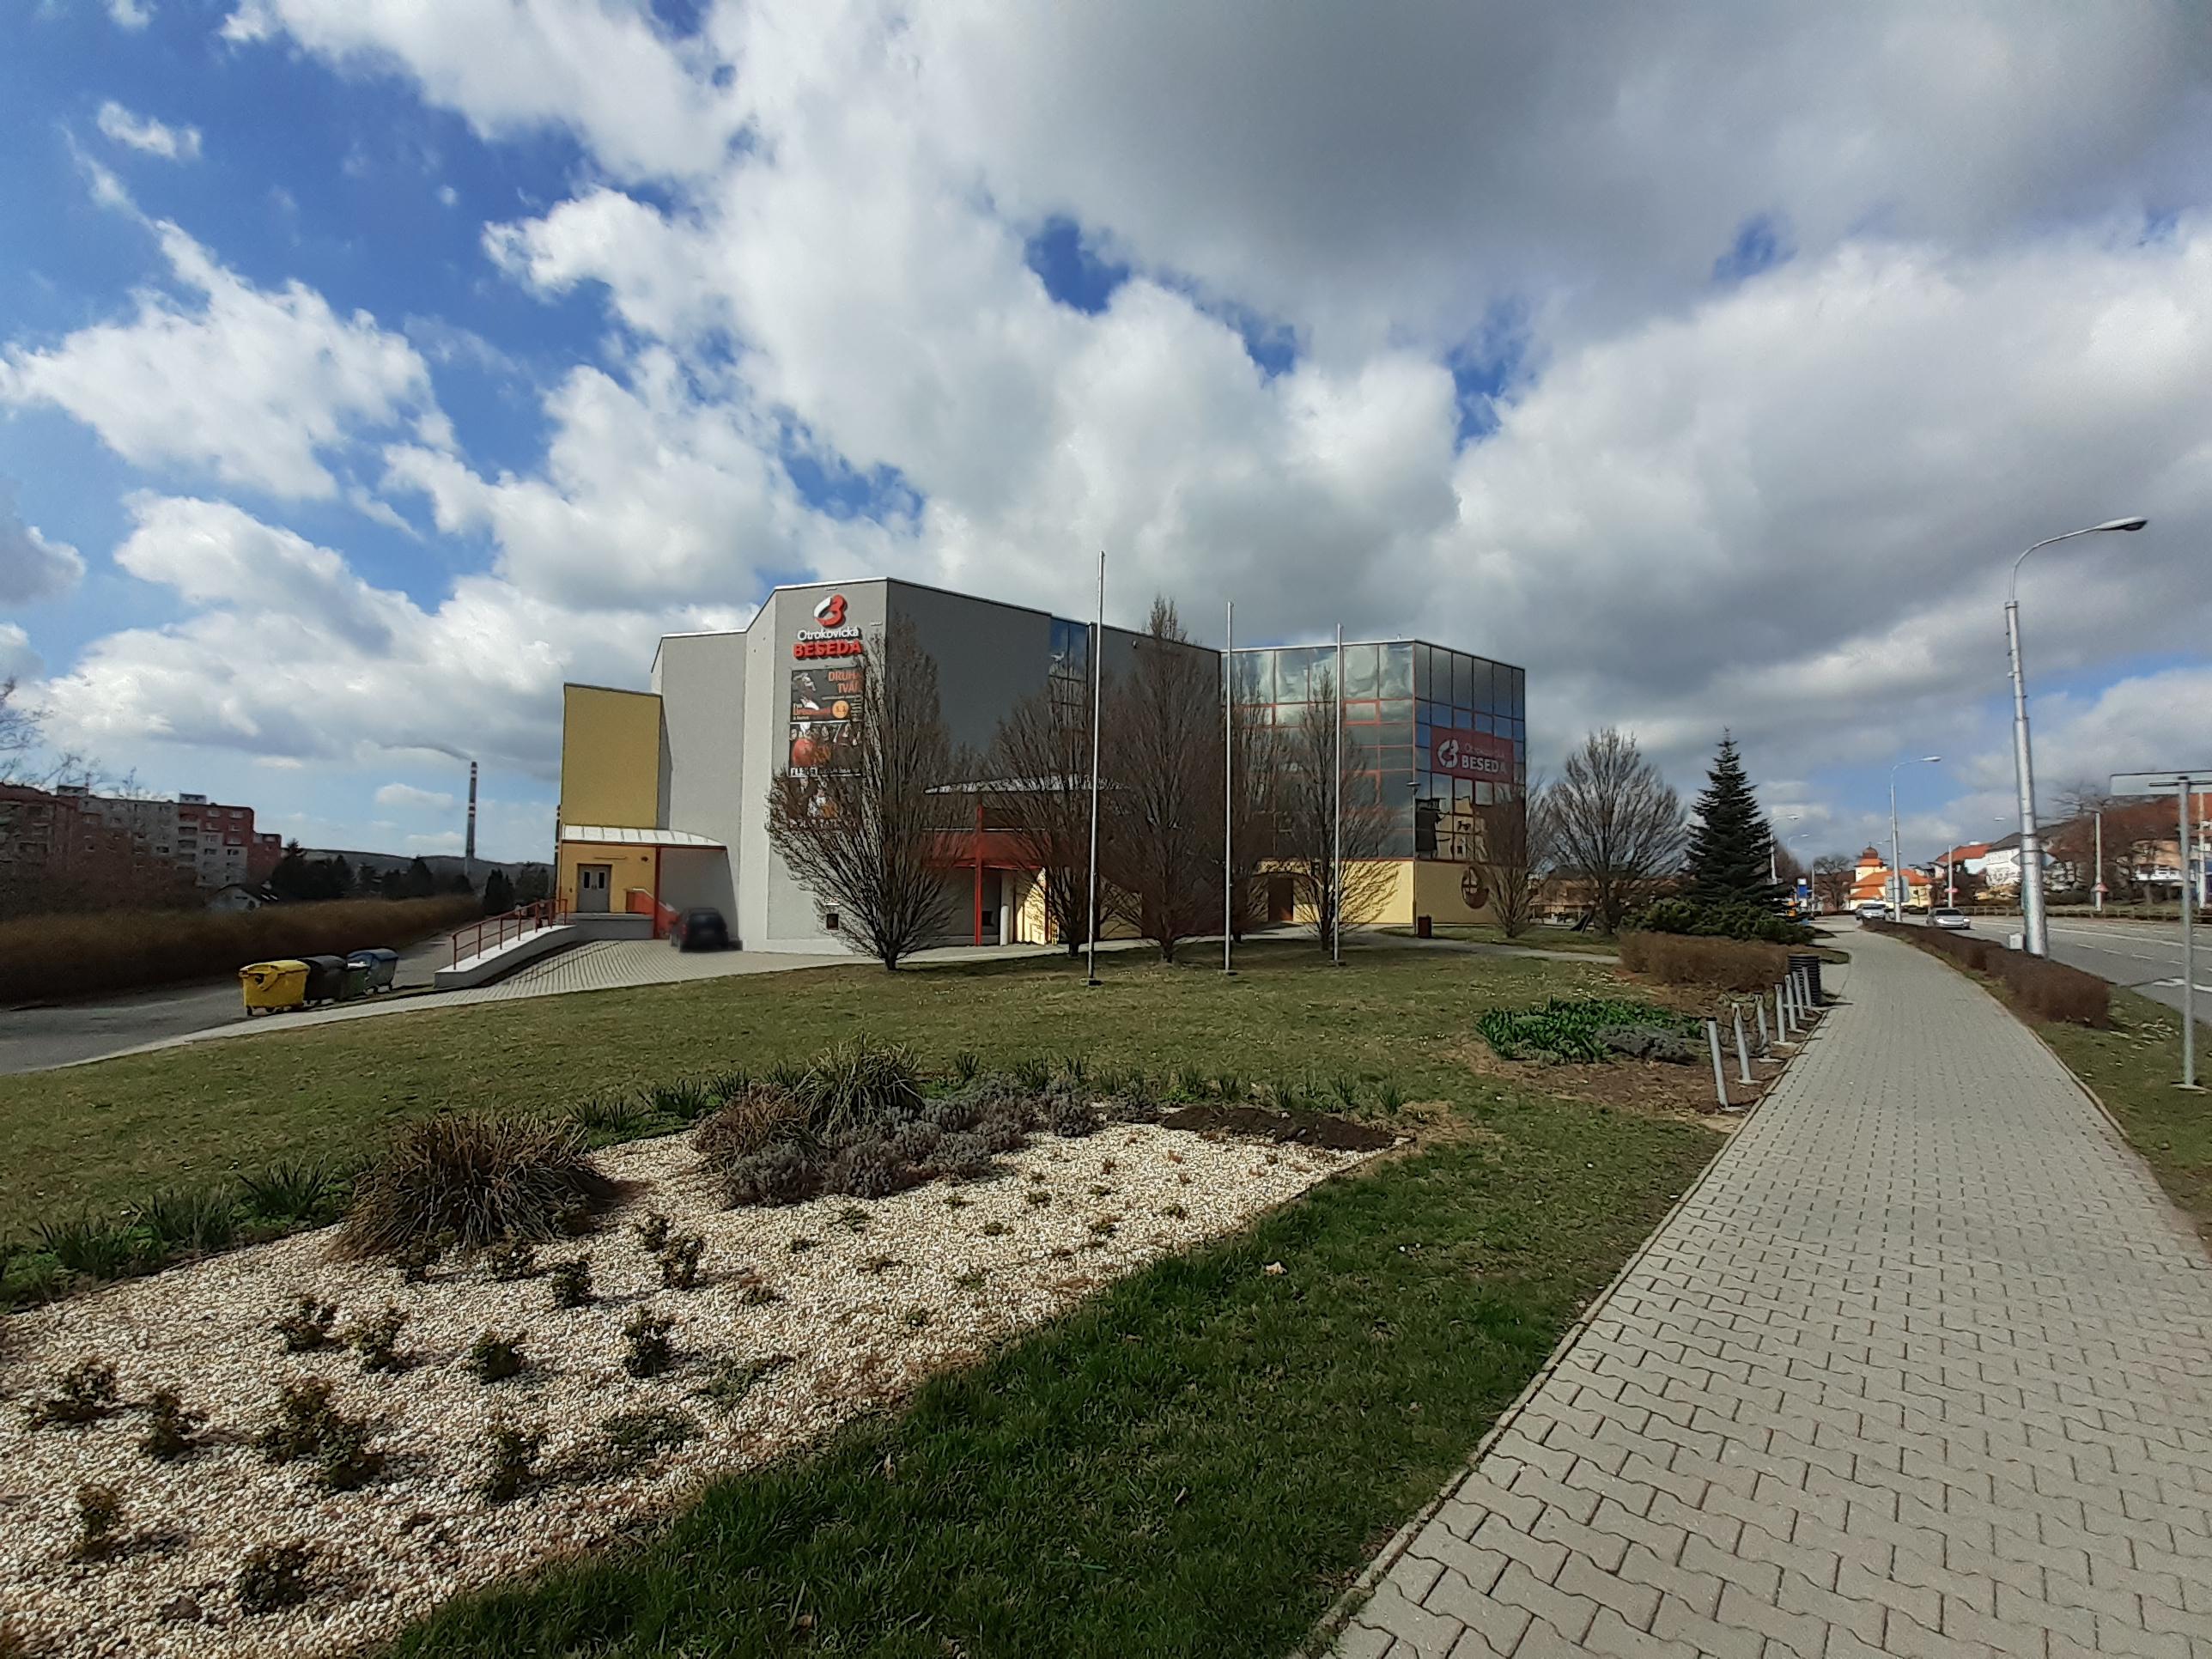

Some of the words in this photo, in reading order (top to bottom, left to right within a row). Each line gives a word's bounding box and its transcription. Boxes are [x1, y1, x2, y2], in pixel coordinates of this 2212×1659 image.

[797, 626, 860, 641] Otrokovická
[793, 639, 862, 658] BESEDA
[1462, 754, 1507, 775] BESEDA
